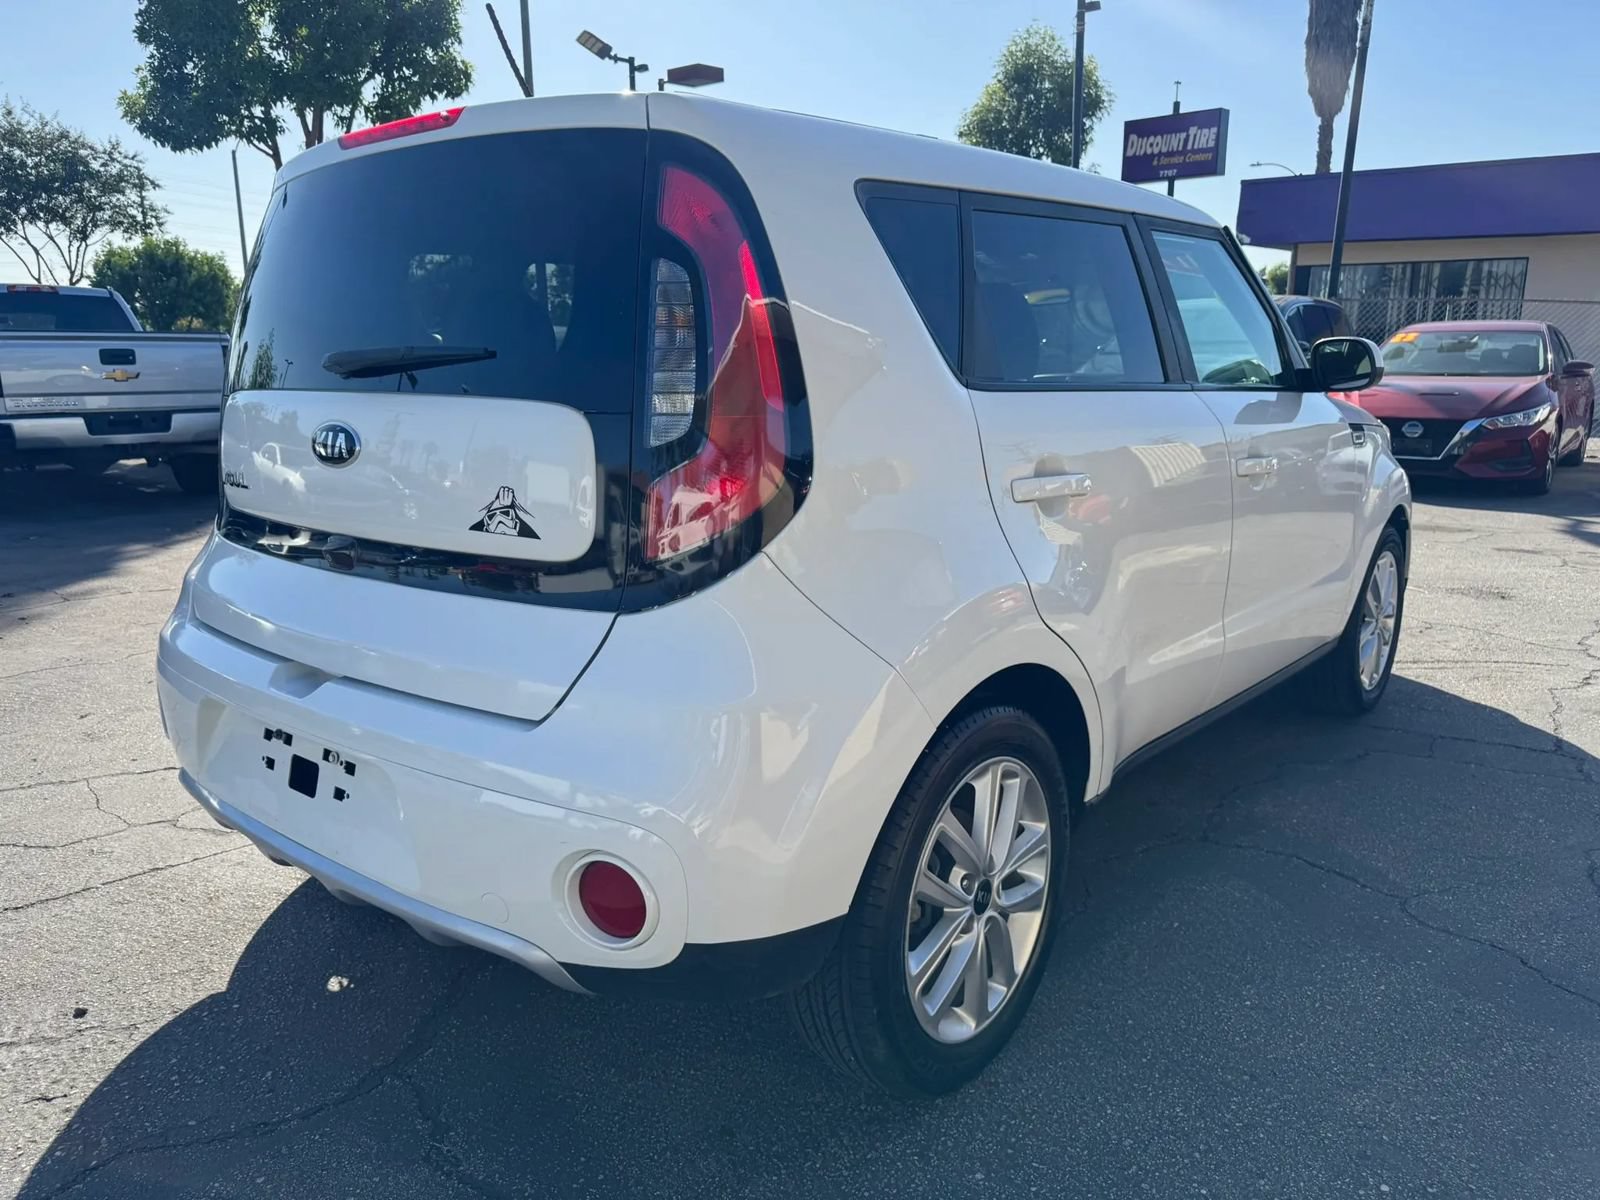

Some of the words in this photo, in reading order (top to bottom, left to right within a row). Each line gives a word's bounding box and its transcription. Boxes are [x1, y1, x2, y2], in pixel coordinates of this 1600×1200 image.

[1126, 131, 1187, 157] DISCOUNT
[1187, 126, 1218, 150] TIRE
[315, 431, 349, 458] KIA
